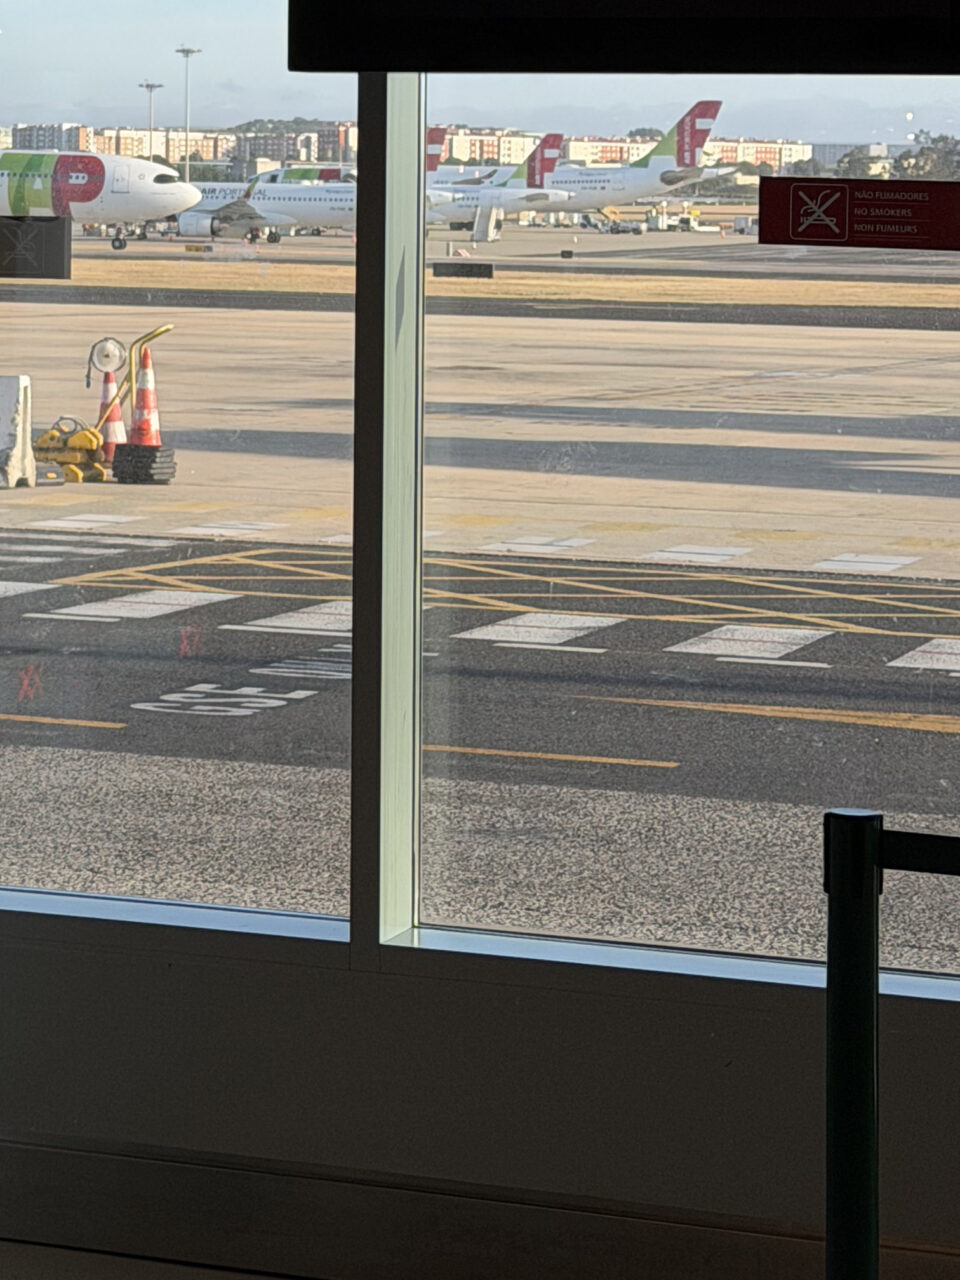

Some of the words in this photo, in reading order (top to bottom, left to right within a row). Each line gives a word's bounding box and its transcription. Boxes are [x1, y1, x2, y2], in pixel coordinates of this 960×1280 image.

[875, 191, 929, 201] FUMADORES
[854, 207, 868, 216] NO
[869, 208, 913, 217] SMOKERS
[854, 223, 874, 232] NON
[129, 683, 319, 716] GSE
